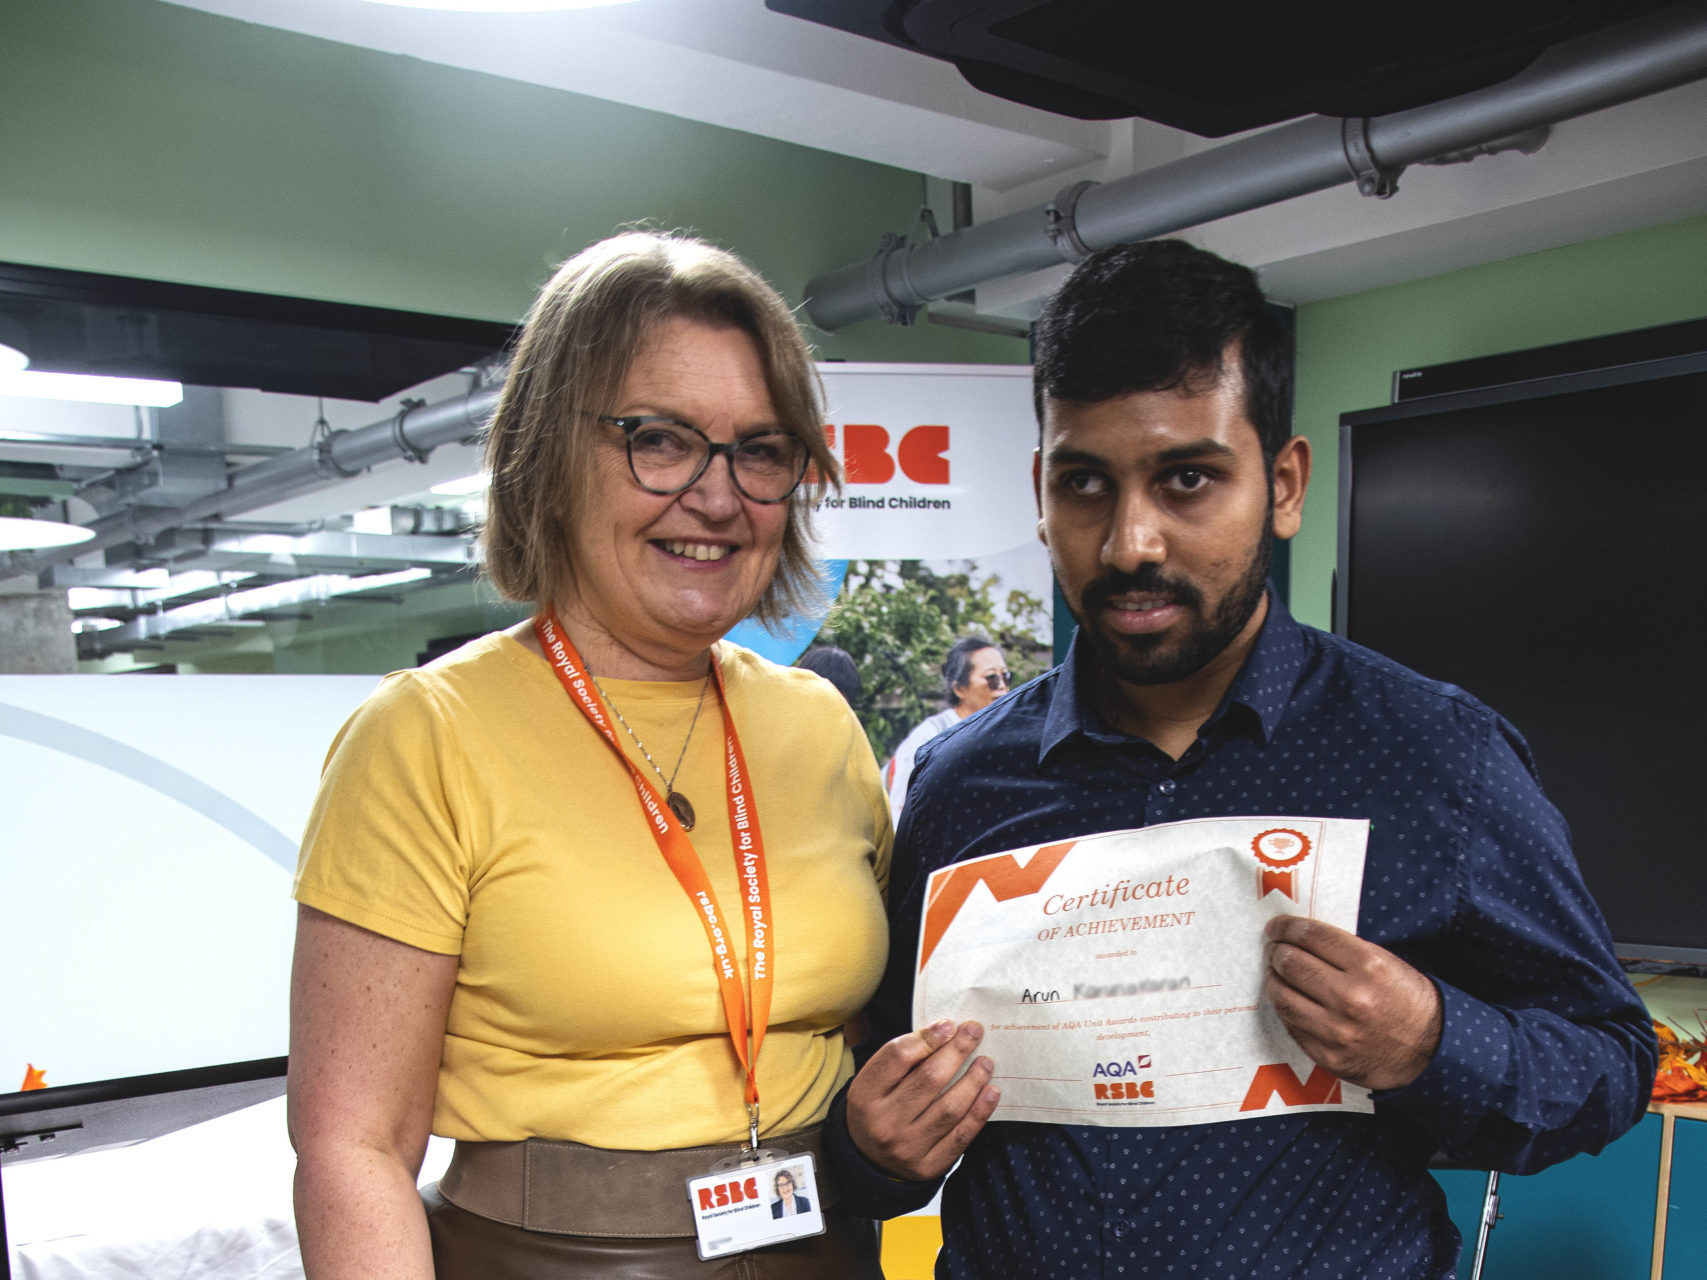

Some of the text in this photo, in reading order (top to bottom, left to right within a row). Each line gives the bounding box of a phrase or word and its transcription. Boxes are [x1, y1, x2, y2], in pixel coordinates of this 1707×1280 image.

[825, 497, 845, 509] for
[849, 496, 885, 509] Blind
[888, 496, 951, 510] Children
[542, 620, 606, 728] The Royal Society
[727, 735, 768, 980] The Royal Society for Blind Children
[1043, 875, 1190, 916] Certificate
[696, 891, 734, 979] rsbc.org.uk
[1037, 911, 1196, 942] OF ACHIEVEMENT
[1021, 988, 1060, 1003] Arun
[1062, 1021, 1082, 1030] AQA
[1139, 1011, 1191, 1023] contributing
[1193, 1009, 1201, 1017] to
[1203, 1006, 1222, 1016] their
[1092, 1060, 1137, 1078] AQA
[1093, 1080, 1155, 1100] RSBC
[697, 1177, 759, 1211] RSBC
